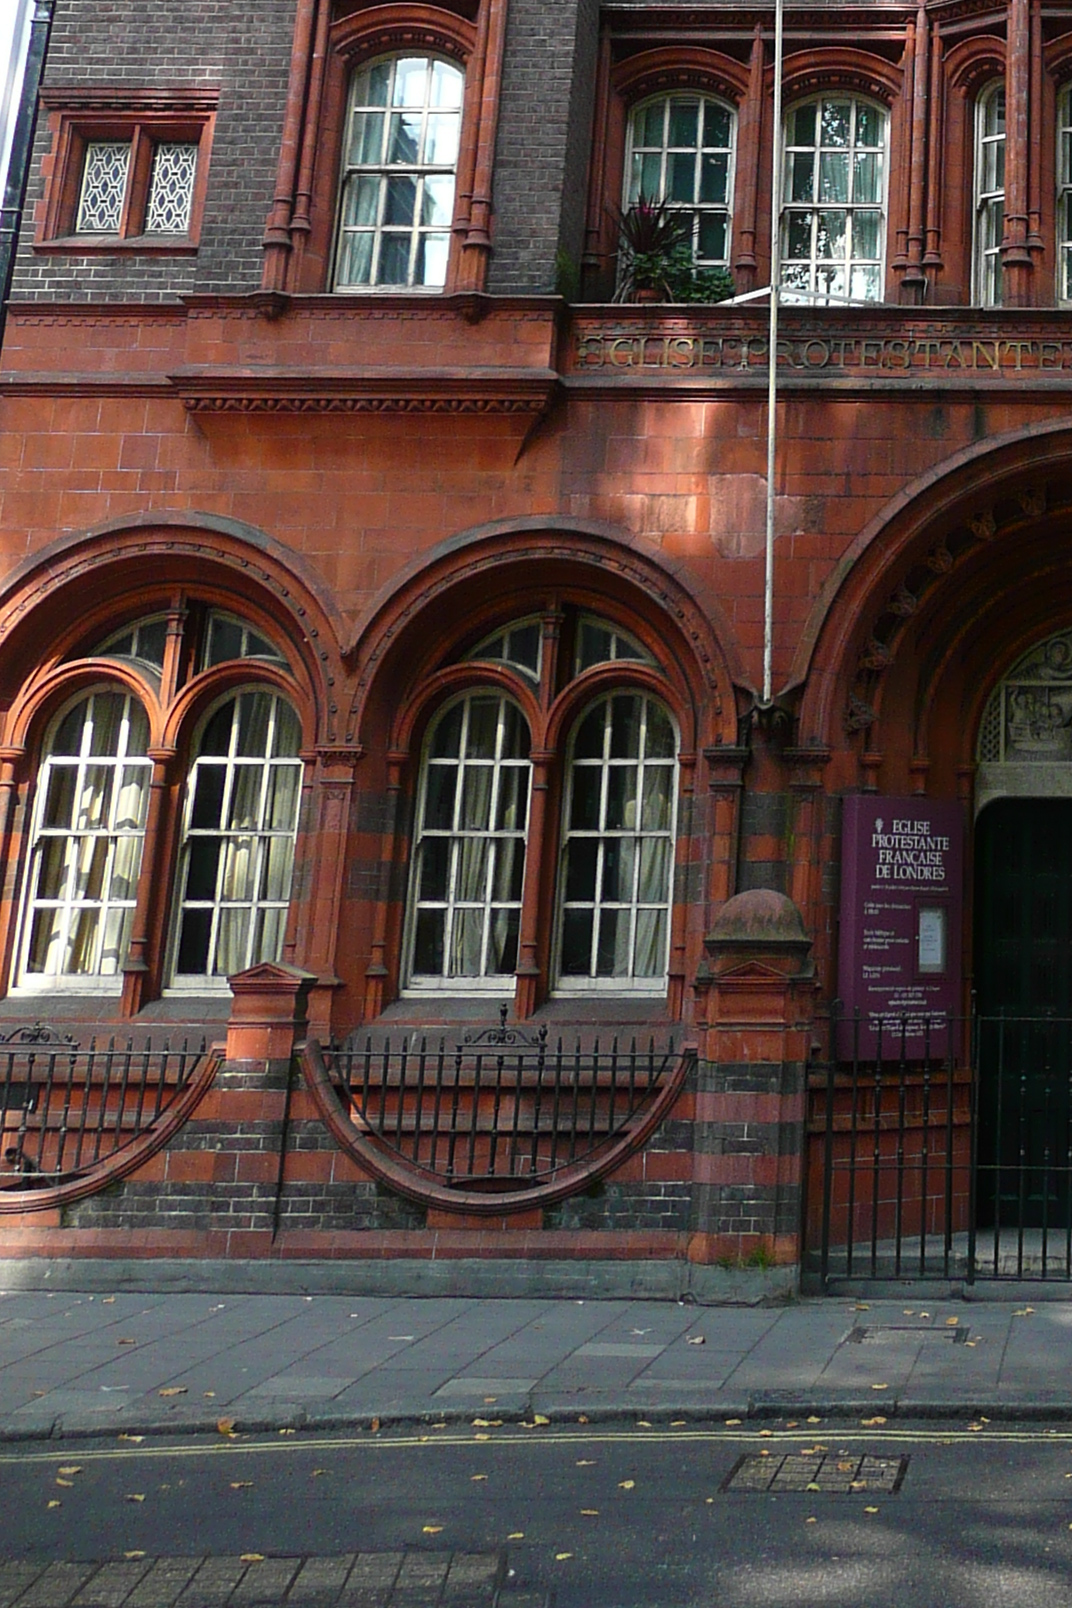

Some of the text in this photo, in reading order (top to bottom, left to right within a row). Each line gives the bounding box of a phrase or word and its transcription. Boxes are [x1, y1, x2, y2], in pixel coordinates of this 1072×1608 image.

[892, 819, 931, 835] EGLISE
[872, 834, 950, 850] PROTESTANTE
[879, 849, 943, 867] FRANÇAISE
[876, 864, 946, 881] DE LONDRES
